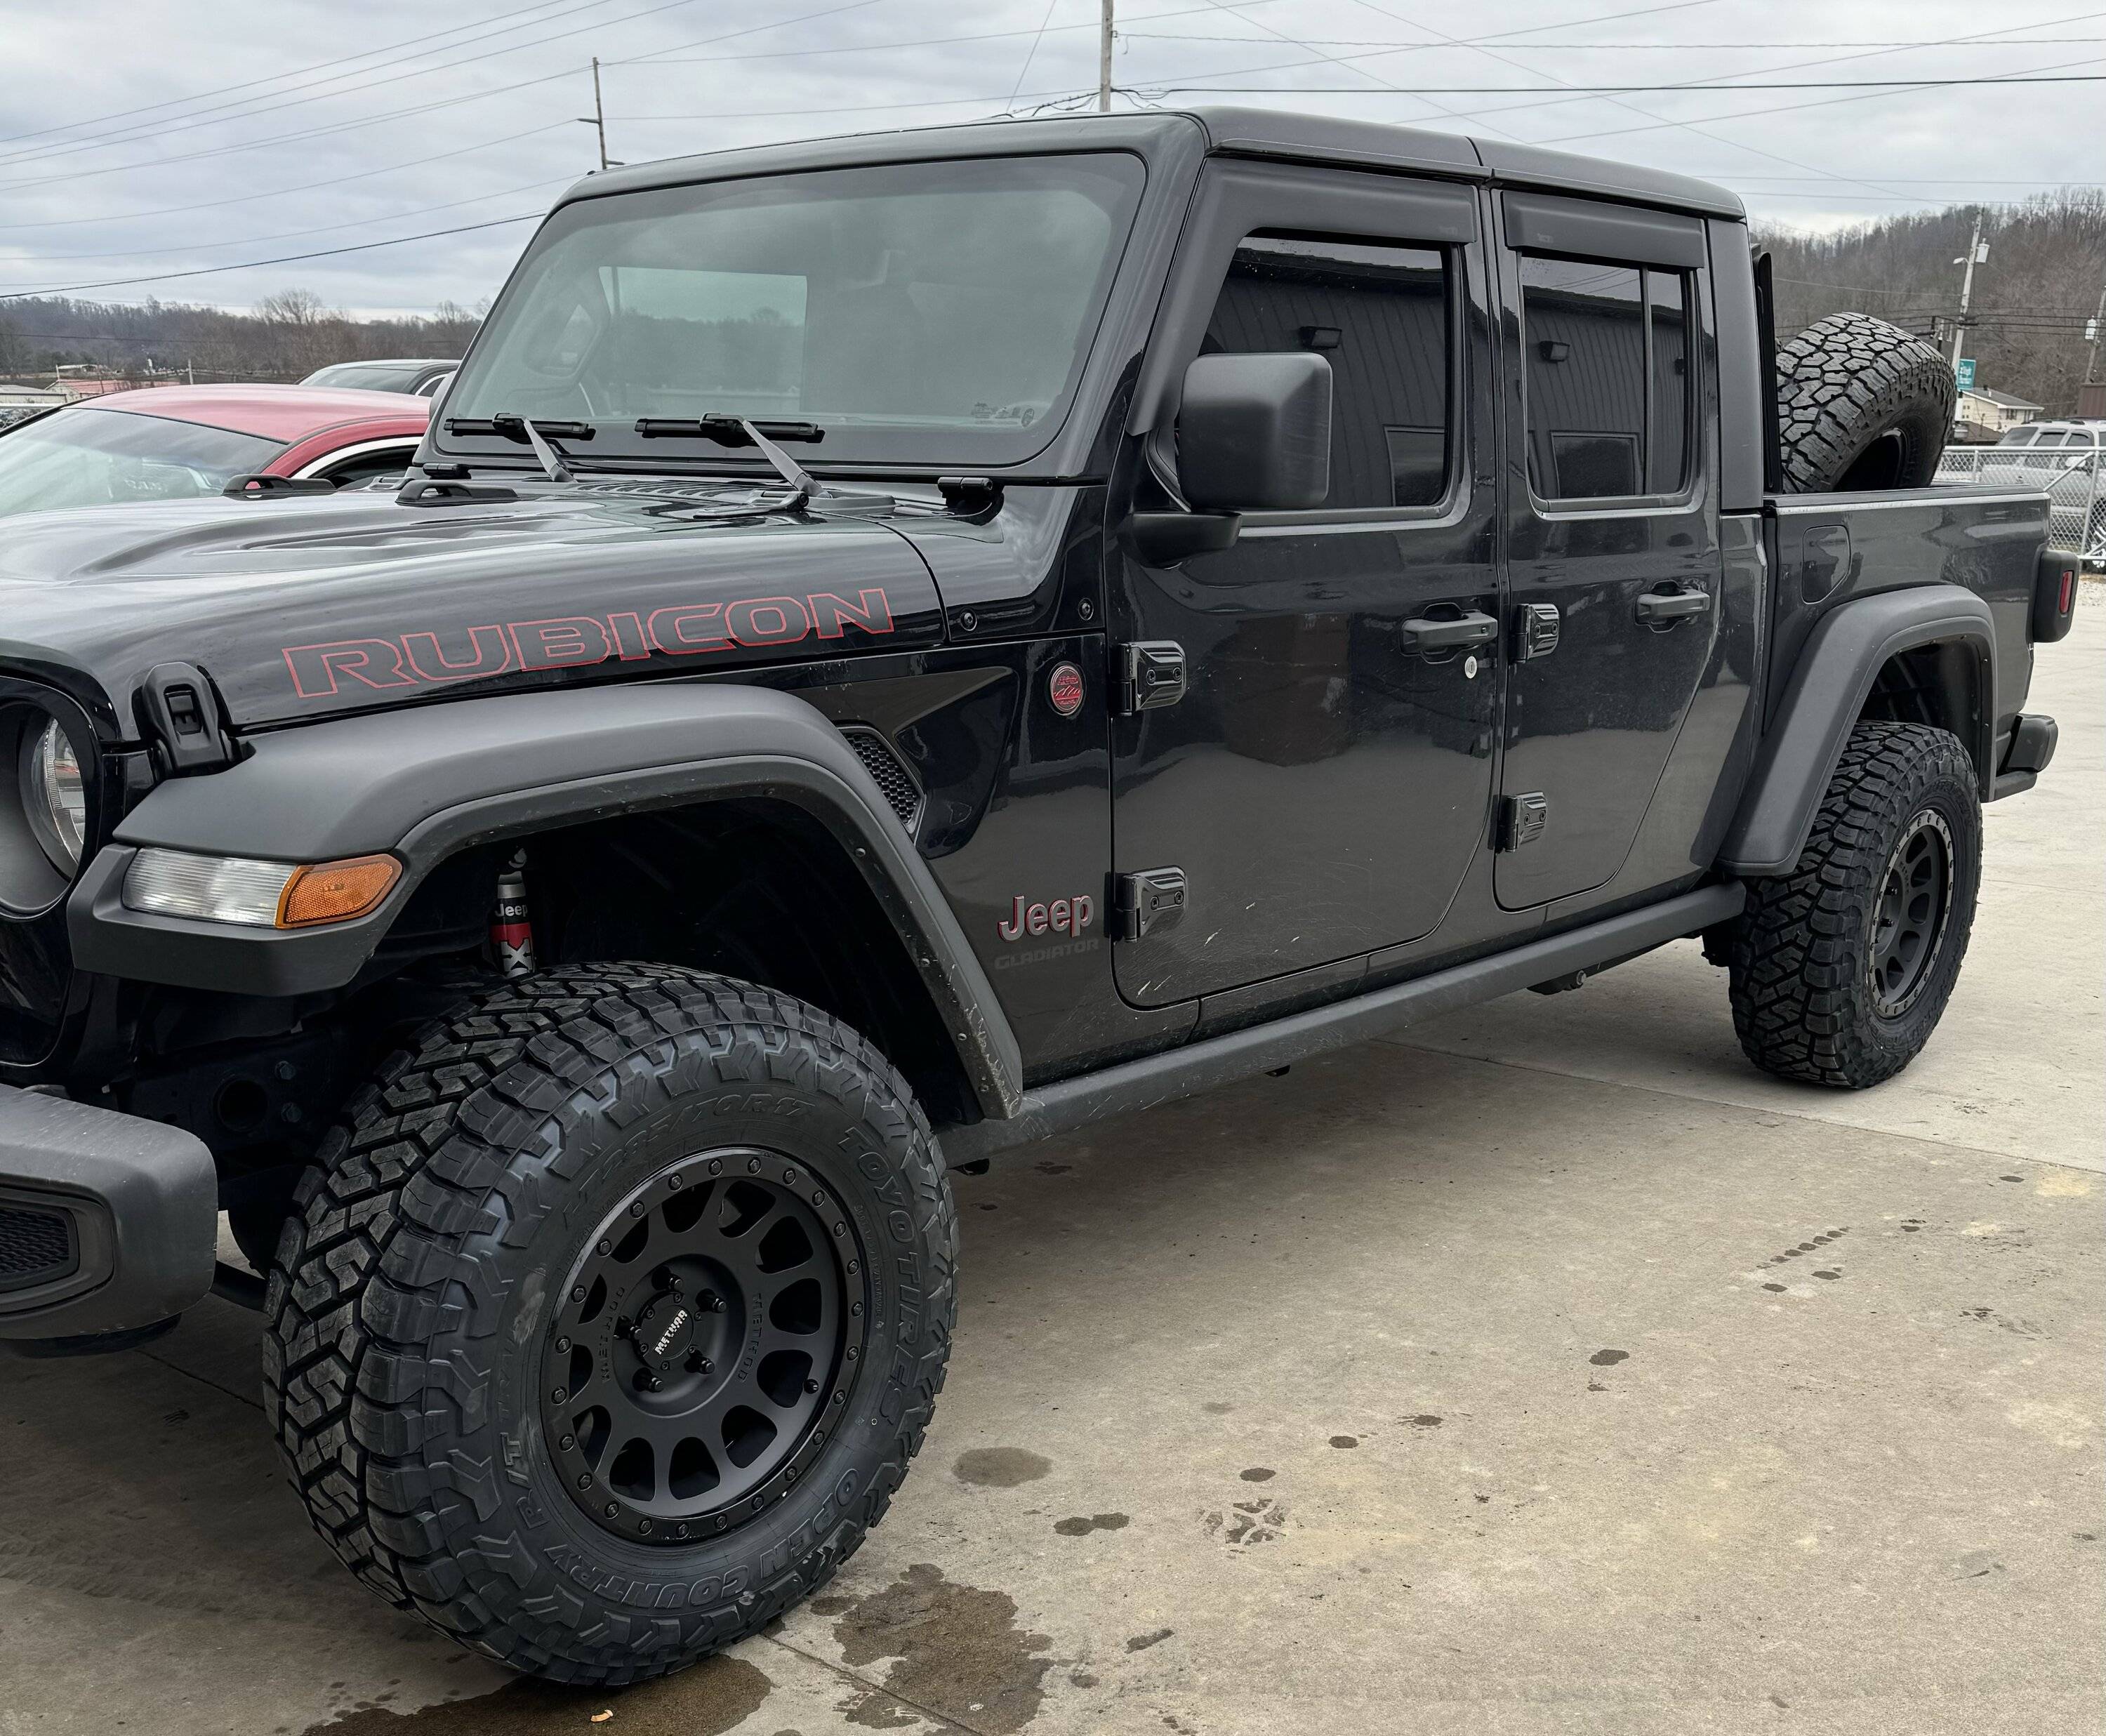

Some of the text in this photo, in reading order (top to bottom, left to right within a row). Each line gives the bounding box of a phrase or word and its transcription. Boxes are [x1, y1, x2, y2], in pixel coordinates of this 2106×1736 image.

[282, 588, 895, 698] RUBICON
[494, 903, 528, 917] Jeep
[994, 939, 1099, 970] GLADIATOR
[997, 894, 1094, 943] Jeep
[837, 1126, 915, 1243] TOYO
[599, 1287, 625, 1384] METHOD
[736, 1292, 763, 1384] METHOD
[760, 1468, 859, 1579] OPEN
[543, 1543, 750, 1608] COUNTRY
